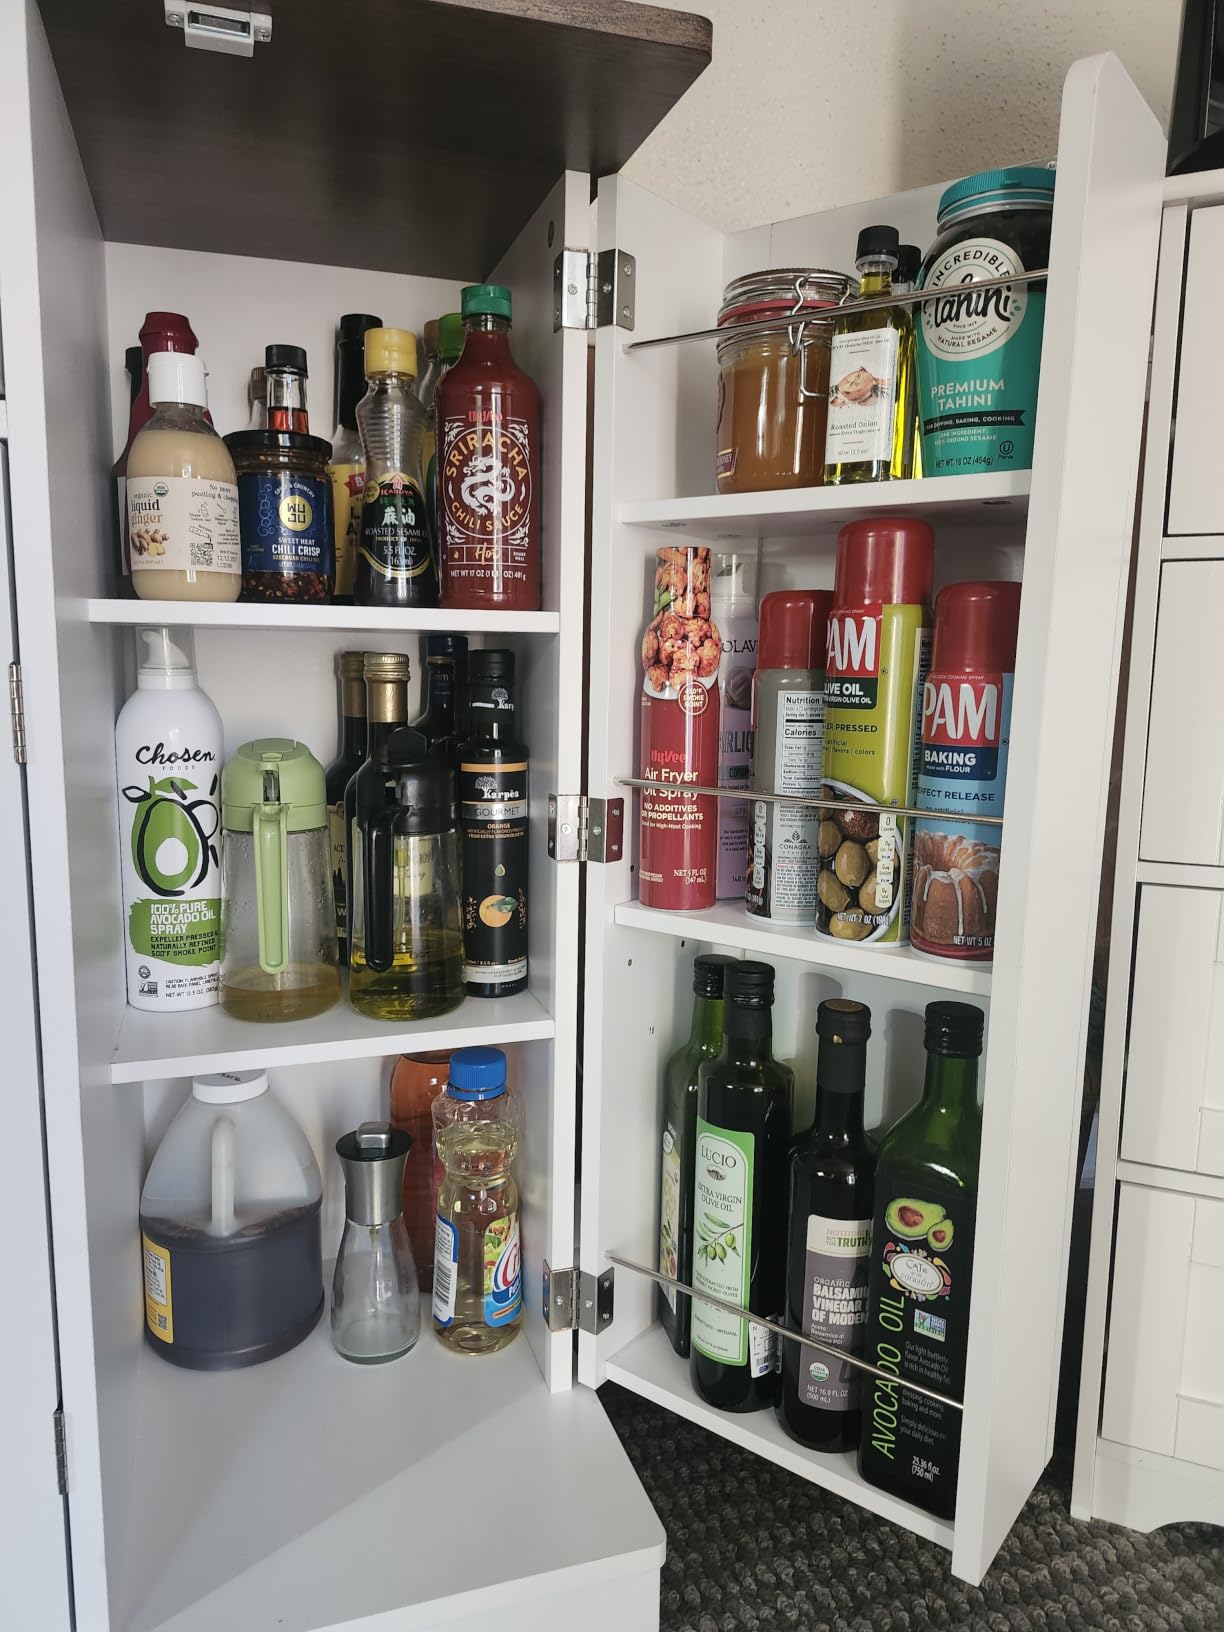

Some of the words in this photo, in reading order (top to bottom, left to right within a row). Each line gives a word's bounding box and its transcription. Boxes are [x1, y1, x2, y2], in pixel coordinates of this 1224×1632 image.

[933, 250, 1010, 286] INCREDIBLE
[937, 336, 965, 347] NATURAL
[967, 327, 997, 346] SESAME
[931, 378, 1005, 398] PREMIUM
[938, 393, 992, 410] TAHINI
[831, 421, 857, 430] Roasted
[859, 420, 878, 428] Onion
[956, 417, 981, 425] BAKING,
[982, 415, 1015, 423] COOKING
[446, 431, 528, 480] SRIRACHA
[936, 460, 945, 469] NET
[963, 457, 972, 465] OZ
[973, 456, 994, 467] (454g)
[293, 482, 316, 498] CRUNCHY
[287, 502, 306, 514] WU
[451, 502, 480, 529] CHILI
[486, 504, 524, 532] SAUCE
[365, 527, 394, 536] ROASTED
[278, 537, 300, 545] SWEET
[271, 544, 295, 555] CHILI
[298, 545, 321, 557] CRISP
[470, 569, 475, 577] 17
[825, 616, 877, 671] AM
[824, 682, 840, 694] LIVE
[842, 683, 864, 695] OIL
[786, 696, 820, 705] Nutrition
[921, 683, 998, 741] PAM
[785, 728, 817, 737] Calories
[835, 723, 878, 733] PRESSED
[136, 742, 215, 765] Chosen
[924, 750, 977, 766] BAKING
[644, 767, 659, 780] Air
[661, 769, 699, 784] Fryer
[945, 765, 971, 773] FLOUR
[659, 789, 698, 801] Spray
[944, 791, 995, 801] RELEASE
[474, 806, 521, 817] GOURMET
[654, 804, 698, 812] ADDITIVES
[648, 812, 704, 820] PROPELLANTS
[673, 869, 686, 877] NET
[151, 903, 179, 915] 100%
[180, 901, 208, 914] PURE
[150, 913, 200, 925] AVOCADO
[201, 909, 217, 921] OIL
[837, 912, 847, 921] NET
[848, 913, 857, 922] WT
[864, 915, 872, 924] OZ
[150, 923, 188, 935] SPRAY
[151, 935, 184, 943] EXPELLER
[186, 931, 213, 941] PRESSED
[953, 935, 966, 945] NET
[967, 936, 977, 946] WT
[978, 936, 983, 947] 5
[984, 937, 992, 947] OZ
[151, 941, 187, 950] NATURALLY
[189, 938, 216, 947] REFINED
[173, 948, 196, 957] SMOKE
[198, 944, 217, 954] POINT
[701, 1144, 737, 1169] LUCIO
[701, 1194, 719, 1209] OLIVE
[720, 1203, 734, 1212] OIL
[714, 1190, 742, 1204] VIRGIN
[837, 1229, 868, 1248] TRUTH
[814, 1276, 851, 1288] ORGANIC
[812, 1295, 863, 1313] VINEGAR
[811, 1308, 826, 1322] OF
[879, 1296, 905, 1332] OIL
[810, 1328, 838, 1339] Balsamico
[811, 1322, 827, 1332] Aceto
[905, 1340, 915, 1351] Our
[915, 1343, 927, 1356] light
[904, 1349, 919, 1362] flavor
[918, 1356, 941, 1371] Avocado
[909, 1362, 919, 1373] rich
[924, 1367, 942, 1384] healthy
[806, 1392, 819, 1401] (500
[807, 1384, 818, 1393] NET
[832, 1389, 839, 1397] FL
[871, 1343, 902, 1460] AVOCADO
[901, 1396, 919, 1413] baking
[918, 1405, 929, 1414] and
[900, 1414, 918, 1430] Simply
[917, 1423, 939, 1438] delicious
[900, 1426, 911, 1436] your
[911, 1430, 924, 1442] daily
[912, 1455, 928, 1470] 25.36
[911, 1464, 925, 1478] (750
[924, 1471, 934, 1484] ml)
